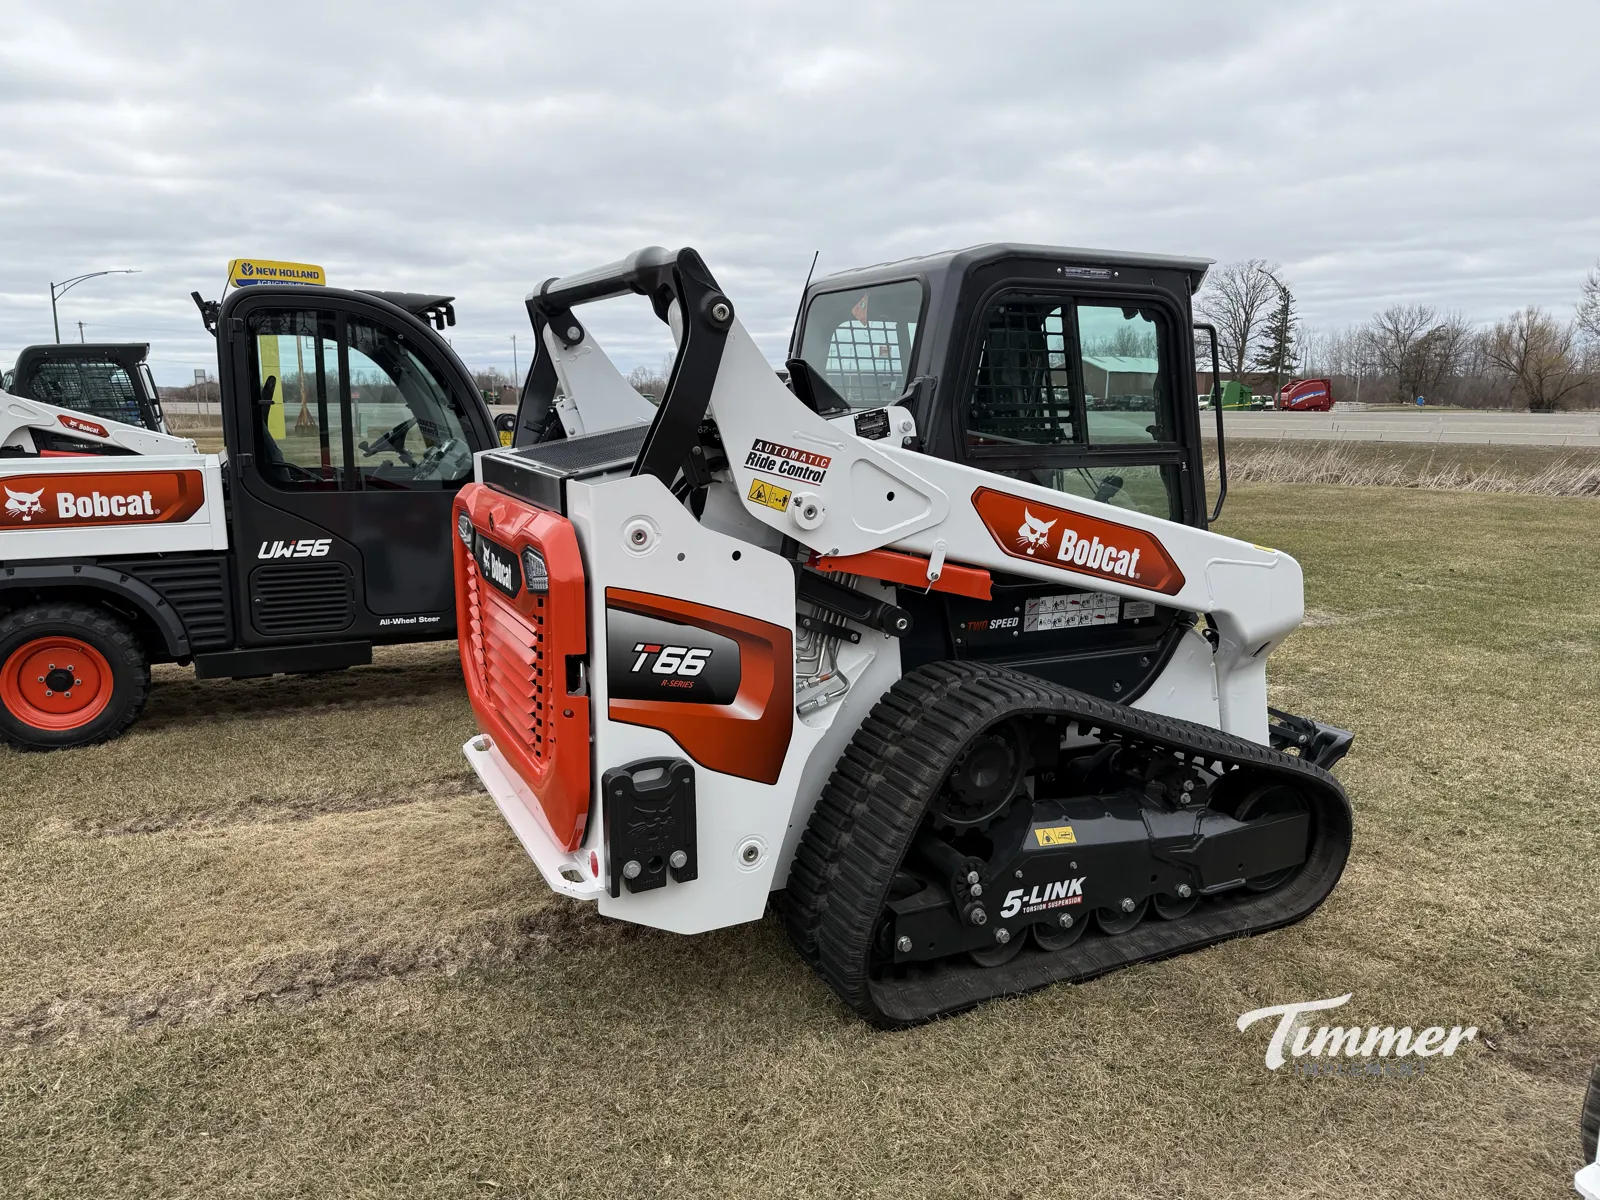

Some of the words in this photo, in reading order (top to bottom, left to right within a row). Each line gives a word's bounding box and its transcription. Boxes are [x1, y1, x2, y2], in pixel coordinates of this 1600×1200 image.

[256, 267, 277, 276] NEW
[279, 268, 319, 279] HOLLAND
[79, 423, 99, 434] Bobcat
[745, 451, 777, 471] Ride
[778, 460, 827, 483] Control
[755, 441, 828, 467] AUTOMATIC
[56, 490, 155, 519] Bobcat
[1057, 528, 1140, 578] Bobcat
[491, 552, 512, 591] Bobcat
[380, 617, 417, 626] All-Wheel
[967, 620, 988, 631] TWO
[989, 617, 1019, 630] SPEED
[631, 643, 713, 677] T66
[660, 679, 695, 689] R-SERIES
[1000, 876, 1086, 918] 5-LINK
[1023, 902, 1047, 914] TORSION
[1047, 896, 1081, 909] SUSPENSION
